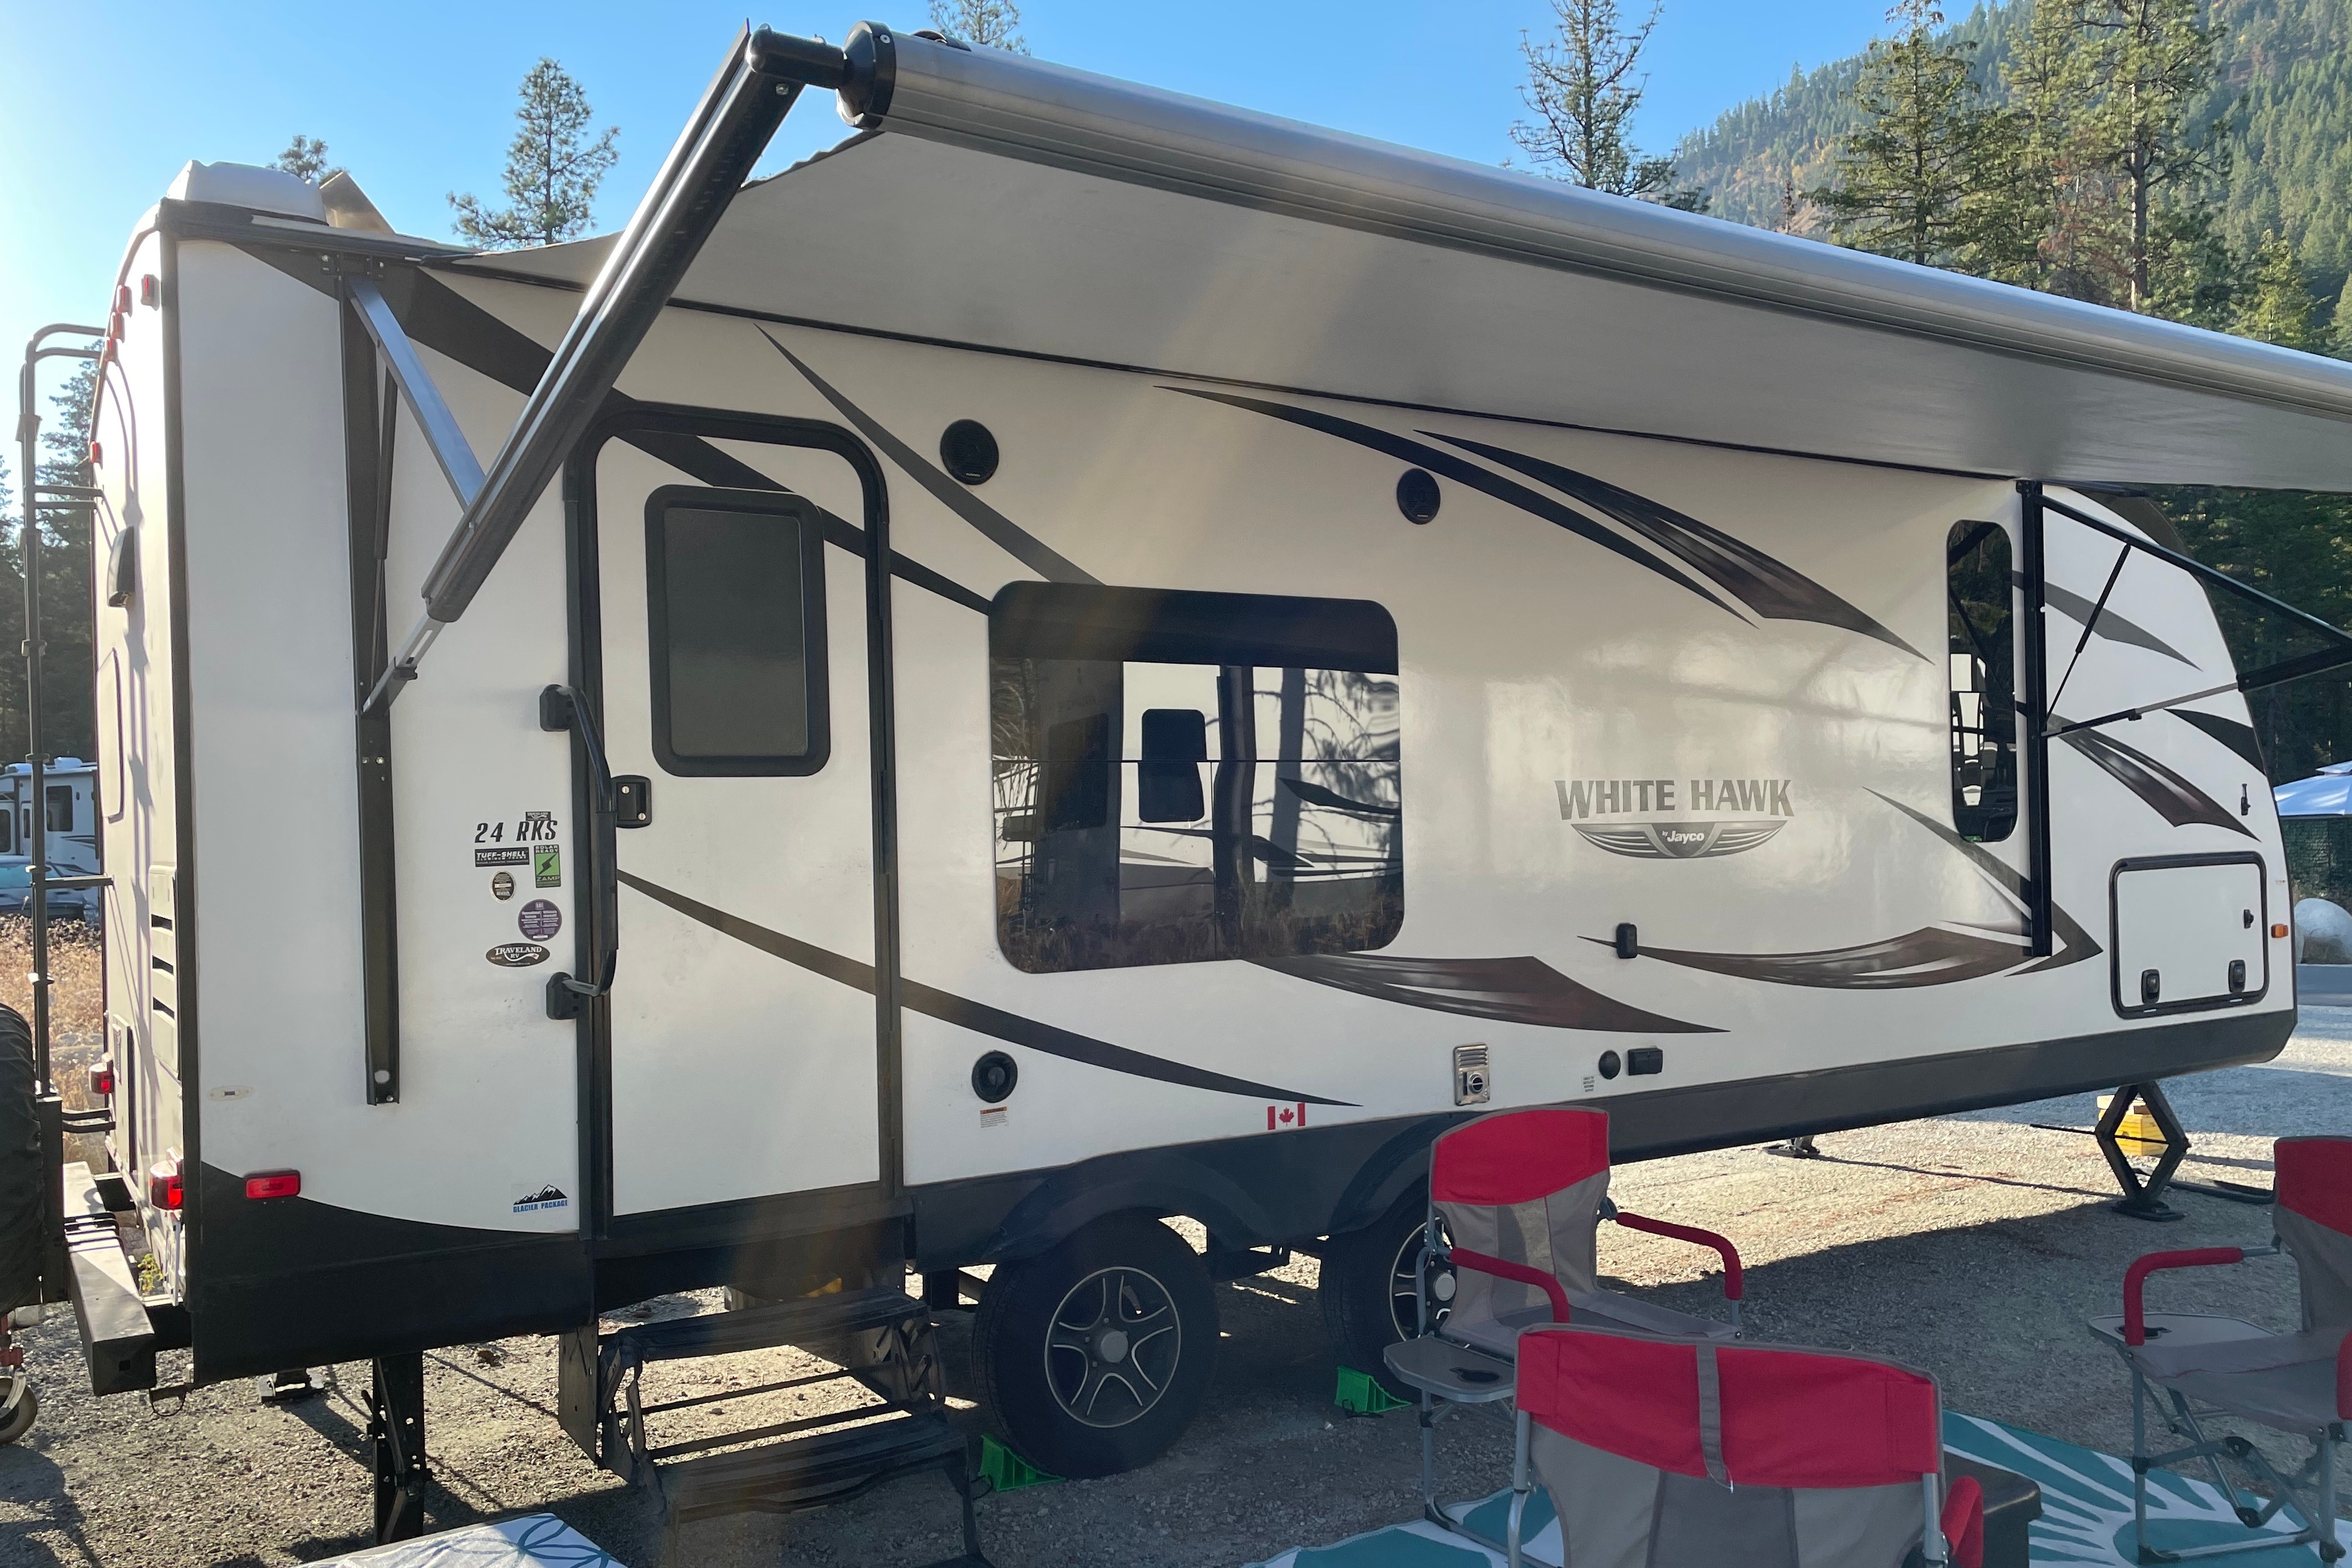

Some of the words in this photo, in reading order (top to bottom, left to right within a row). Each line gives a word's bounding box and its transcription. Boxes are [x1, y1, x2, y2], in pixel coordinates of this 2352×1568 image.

[1554, 780, 1675, 820] WHITE
[1691, 780, 1794, 817] HAWK
[475, 822, 504, 843] 24
[516, 820, 558, 841] RKS
[1667, 830, 1705, 844] Jayco
[476, 851, 526, 859] TUFF-SHELL
[494, 946, 542, 956] TRAVELAND
